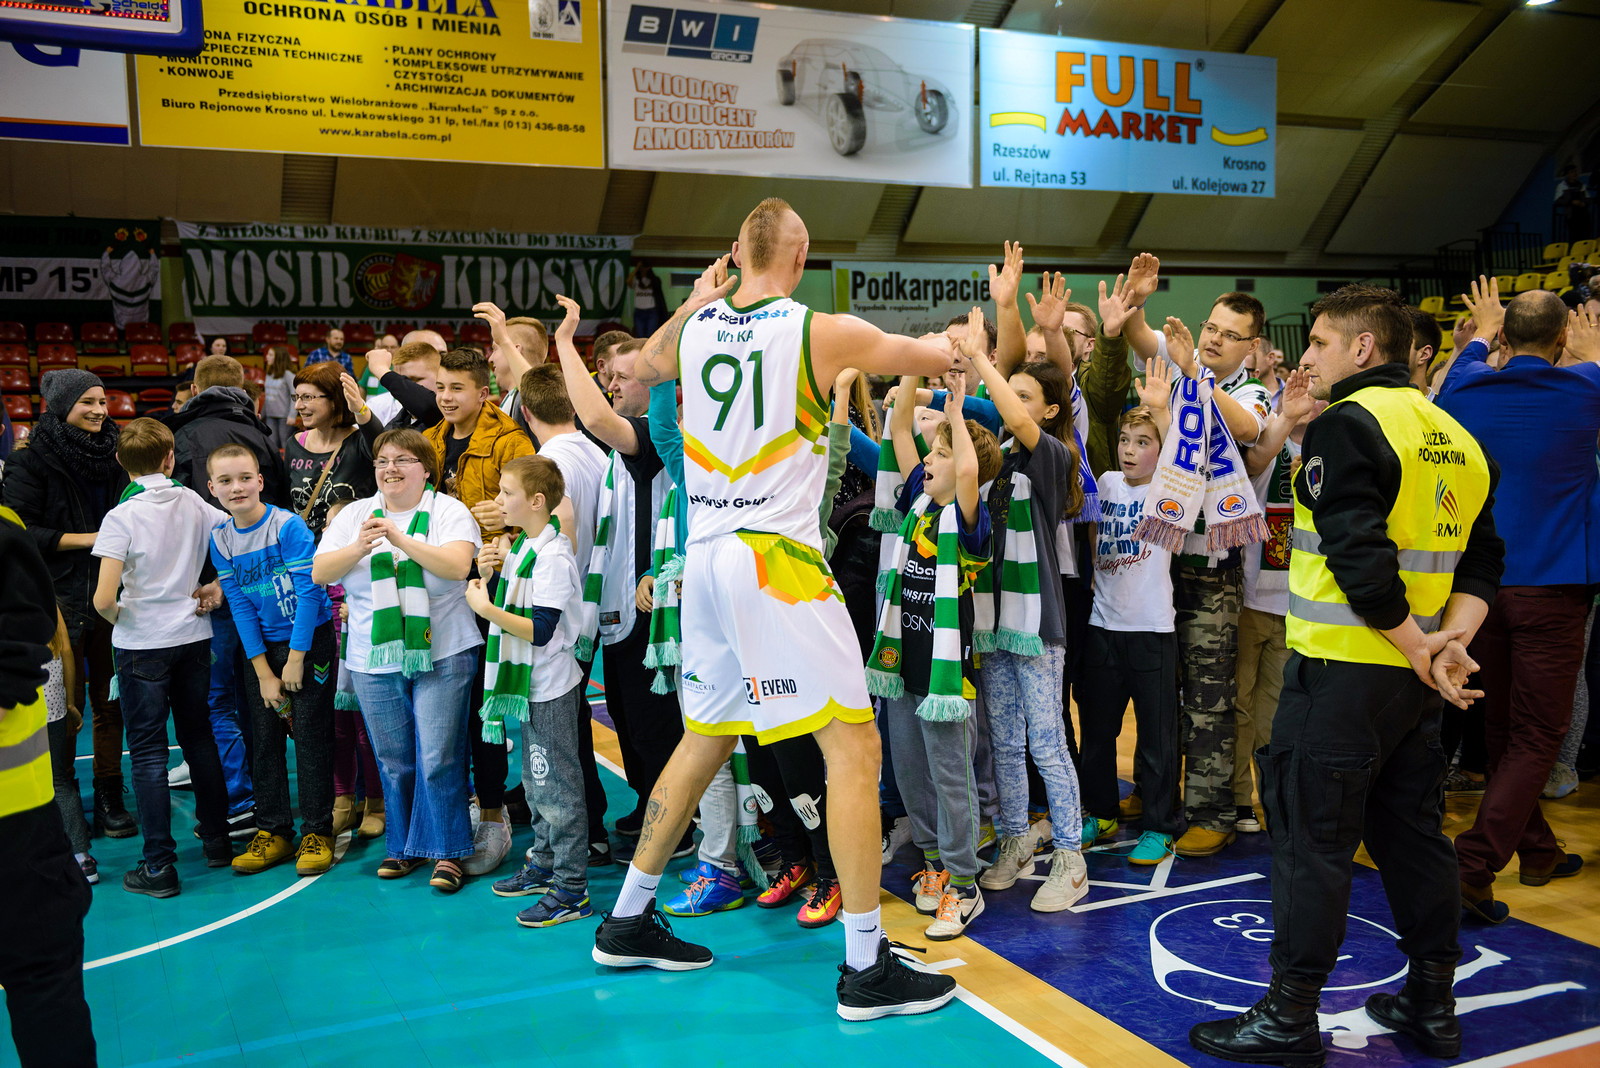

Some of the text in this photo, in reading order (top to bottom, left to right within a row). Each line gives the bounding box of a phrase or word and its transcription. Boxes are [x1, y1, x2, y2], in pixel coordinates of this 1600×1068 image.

[243, 1, 346, 23] OCHRONA
[354, 9, 408, 28] OSÓB
[417, 17, 423, 30] I
[431, 18, 502, 37] MIENIA
[203, 29, 302, 46] ONA FIZYCZNA
[166, 54, 254, 69] MONITORING
[203, 43, 364, 64] ZPIECZENIA TECHNICZNE
[392, 45, 497, 62] PLANY OCHRONY
[710, 51, 750, 63] GROUP
[167, 66, 235, 80] KONWOJE
[392, 58, 585, 81] KOMPLEKSOWE UTRZYMYWANIE
[393, 69, 464, 84] CZYSTOŚCI
[394, 83, 576, 104] ARCHIWIZACJA DOKUMENTÓW
[632, 67, 740, 105] WIODĄCY
[1055, 51, 1203, 115] FULL
[218, 88, 326, 104] Przedsiębiorstwo
[330, 95, 419, 110] Wielobranżowe
[161, 97, 196, 110] Biuro
[199, 100, 262, 114] Rejonowe
[265, 105, 309, 117] Krosno
[311, 108, 327, 118] ul.
[330, 109, 425, 125] Lewakowskiego
[428, 115, 442, 124] 31
[503, 120, 532, 131] (013)
[534, 122, 586, 133] 436-88-58
[634, 97, 758, 128] PRODUCENT
[319, 126, 453, 143] www.karabela.com.pl
[1055, 107, 1203, 145] MARKET
[633, 127, 796, 151] AMORTYZATORÓW
[992, 142, 1051, 160] Rzeszów
[1222, 155, 1267, 172] Krosno
[992, 168, 1088, 187] ul. Rejtana 53
[1171, 177, 1267, 196] ul. Kolejowa 27
[303, 225, 330, 240] DO
[427, 230, 521, 247] SZACUNKU
[527, 234, 551, 248] DO
[555, 235, 618, 250] MIASTA
[186, 248, 355, 309] MOSIR
[441, 254, 626, 312] KROSNO
[851, 270, 991, 308] Podkarpacie
[701, 349, 765, 432] 91
[290, 457, 314, 470] FOR
[902, 611, 936, 635] OSN
